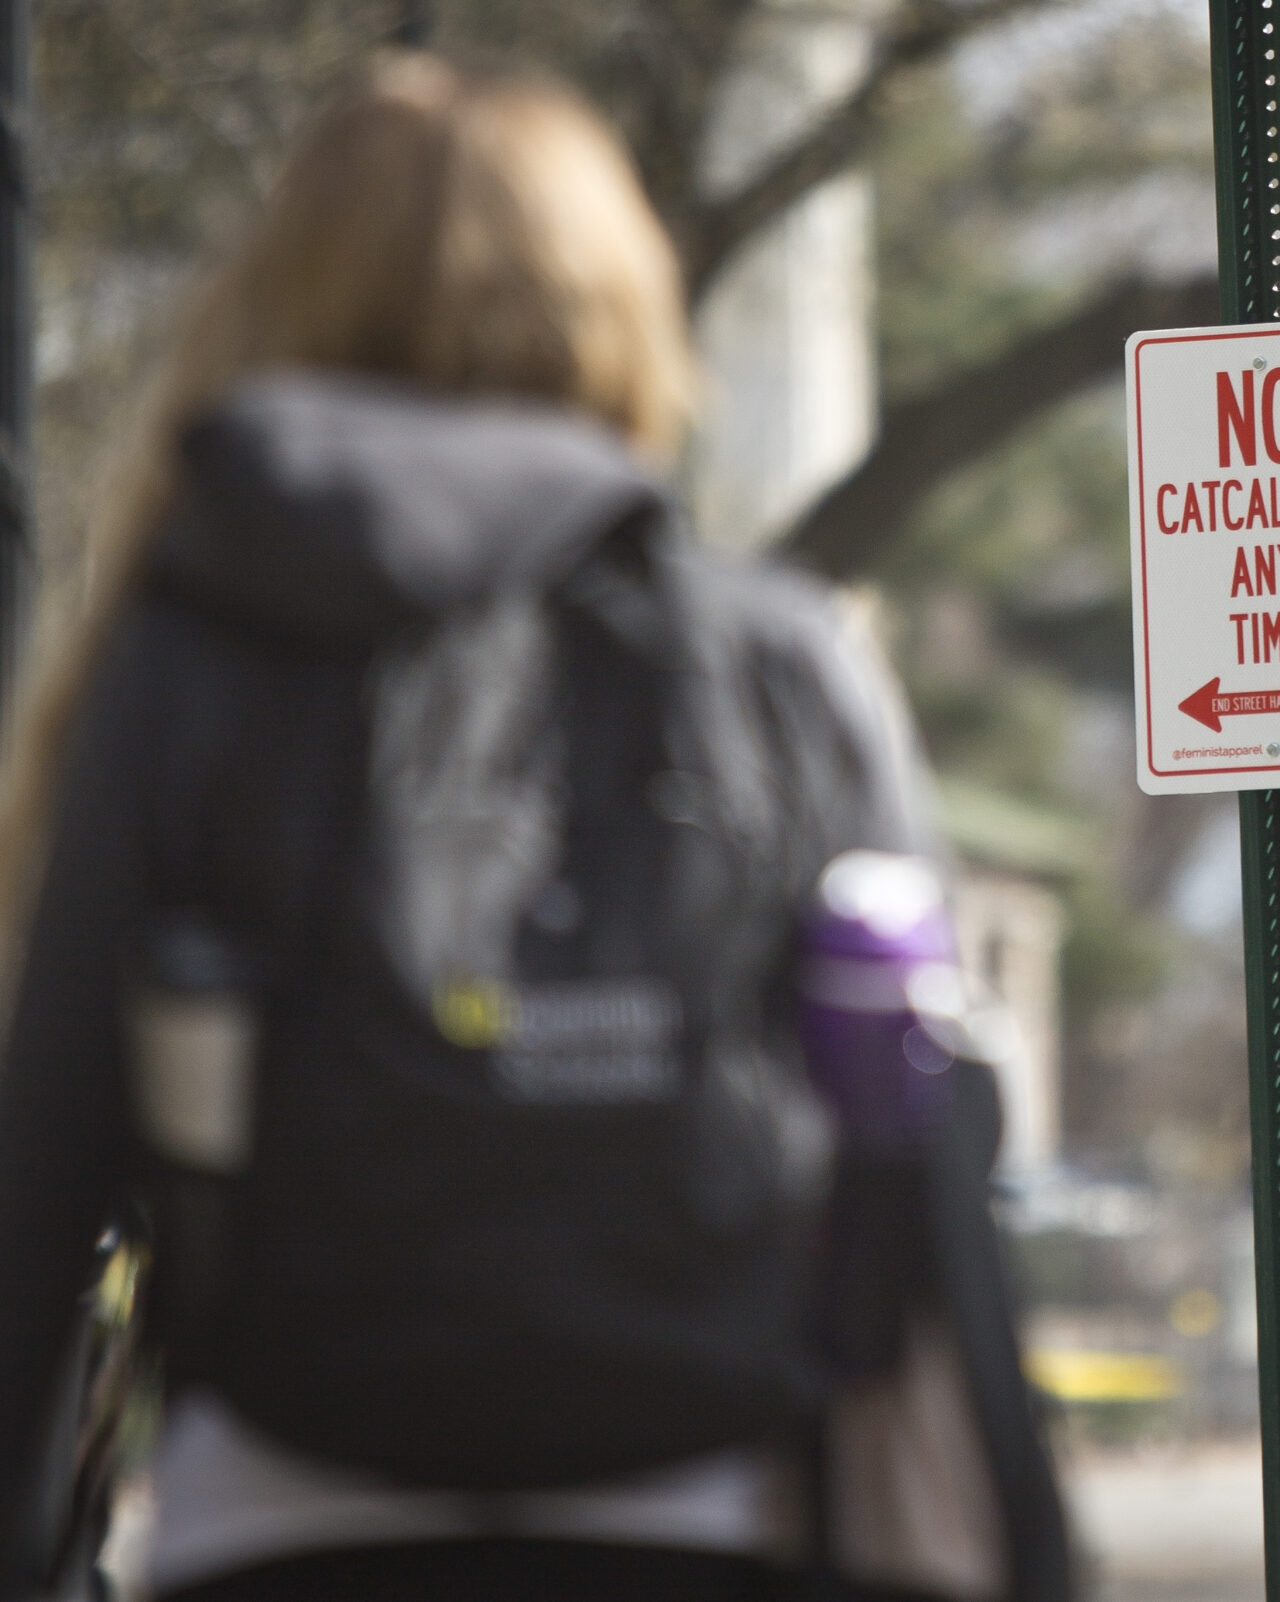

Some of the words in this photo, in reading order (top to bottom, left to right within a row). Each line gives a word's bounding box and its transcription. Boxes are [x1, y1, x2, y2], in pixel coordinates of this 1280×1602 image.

[1211, 698, 1230, 713] END
[1233, 695, 1267, 711] STREET
[1172, 744, 1264, 761] @feministapparel
